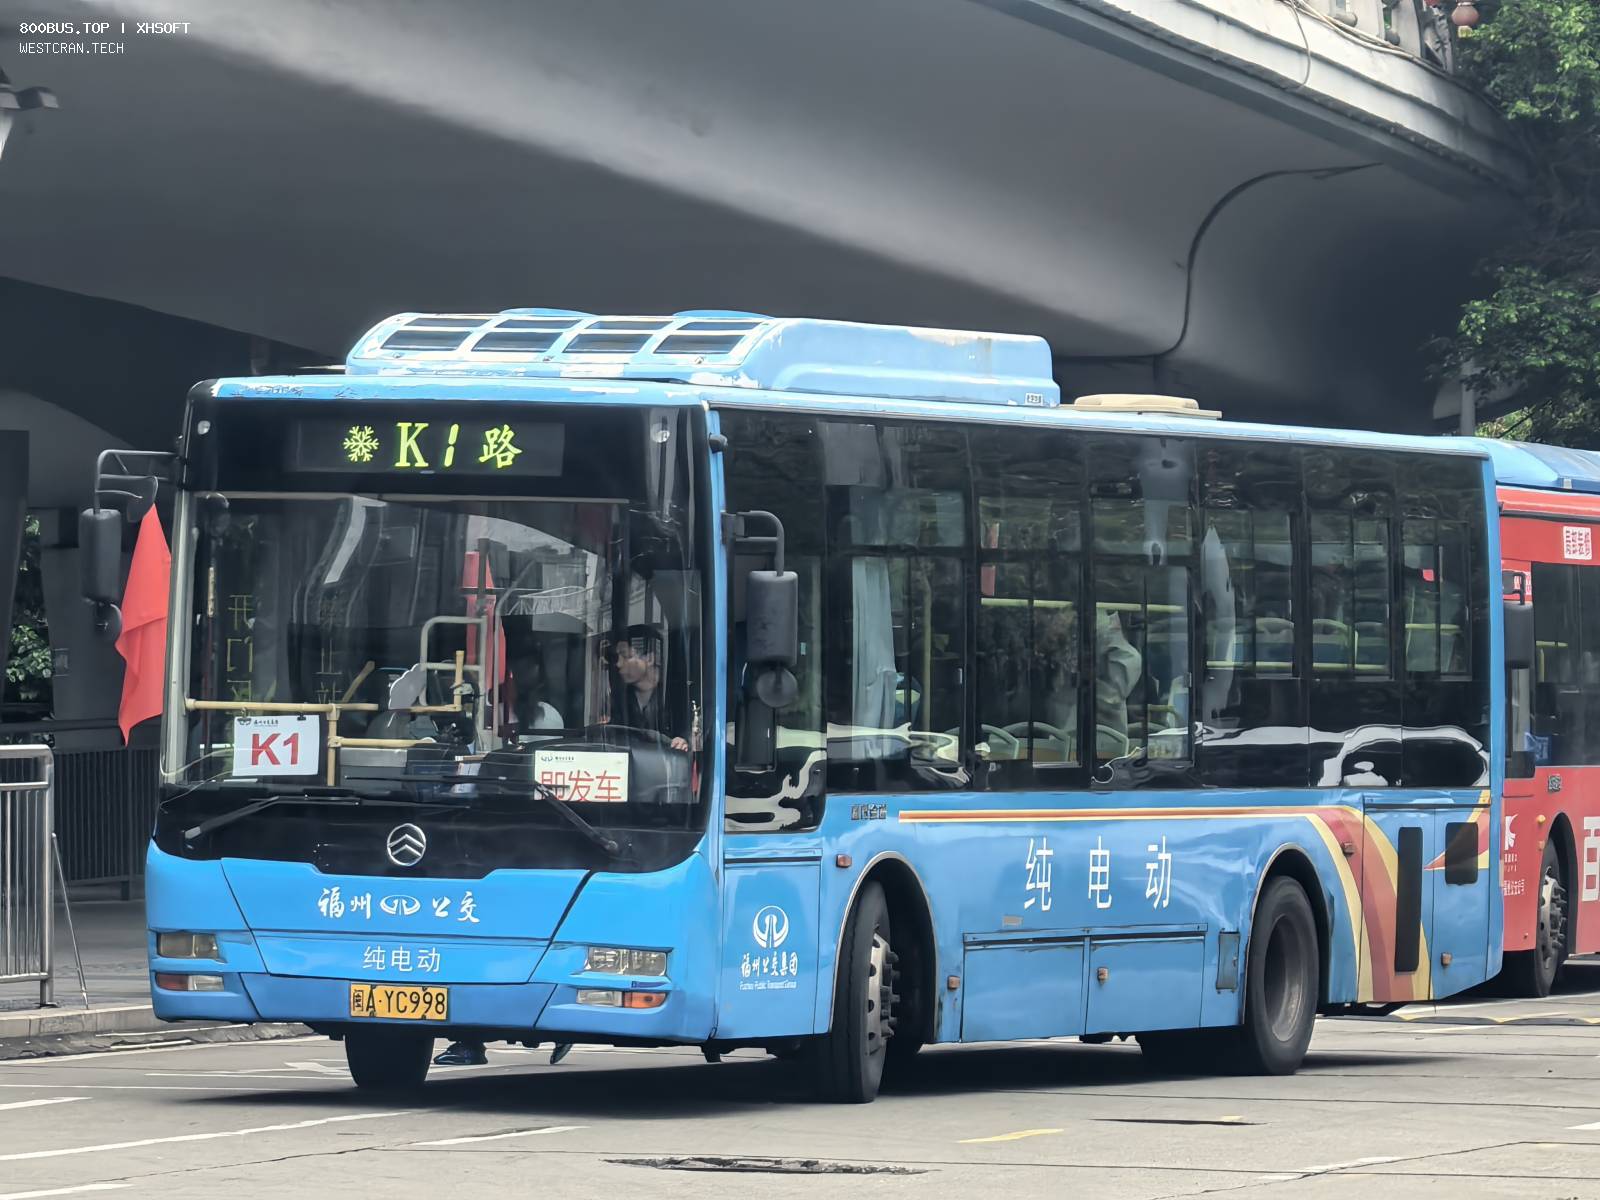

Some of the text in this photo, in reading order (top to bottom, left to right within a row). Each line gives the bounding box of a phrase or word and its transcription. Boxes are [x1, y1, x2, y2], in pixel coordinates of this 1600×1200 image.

[251, 732, 299, 766] K1
[541, 769, 622, 802] 即发车
[1023, 835, 1172, 912] 纯电动
[317, 886, 481, 923] 福州 公交
[362, 945, 441, 973] 纯电动
